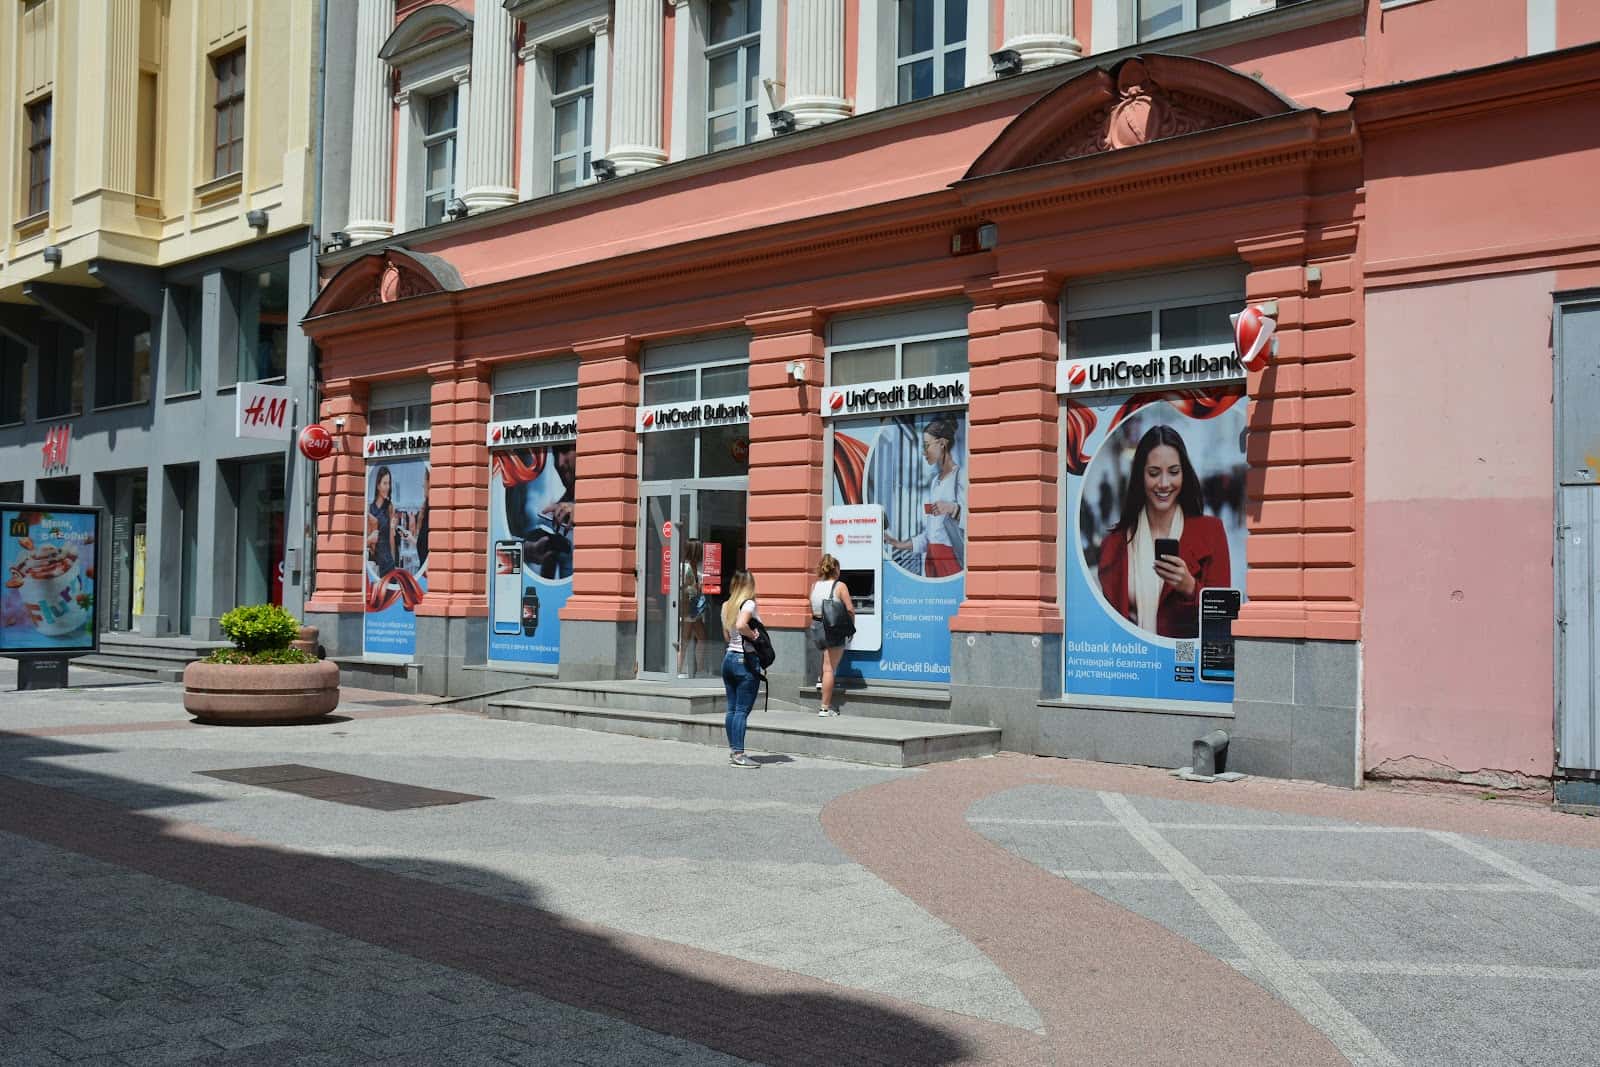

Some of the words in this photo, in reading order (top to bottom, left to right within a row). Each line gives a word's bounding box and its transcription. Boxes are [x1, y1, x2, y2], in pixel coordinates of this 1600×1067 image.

[1090, 357, 1164, 383] UniCredit
[1169, 350, 1242, 377] Bulbank
[845, 385, 905, 407] UniCredit
[908, 380, 965, 402] Bulbank
[244, 395, 288, 429] H&M
[655, 405, 701, 425] UniCredit
[703, 401, 749, 420] Bulbank
[502, 423, 540, 439] UniCredit
[307, 439, 330, 449] 24/7
[375, 437, 407, 452] UniCredit
[1068, 641, 1109, 653] Bulbank
[1112, 643, 1148, 654] Mobile
[888, 660, 922, 673] UniCredit
